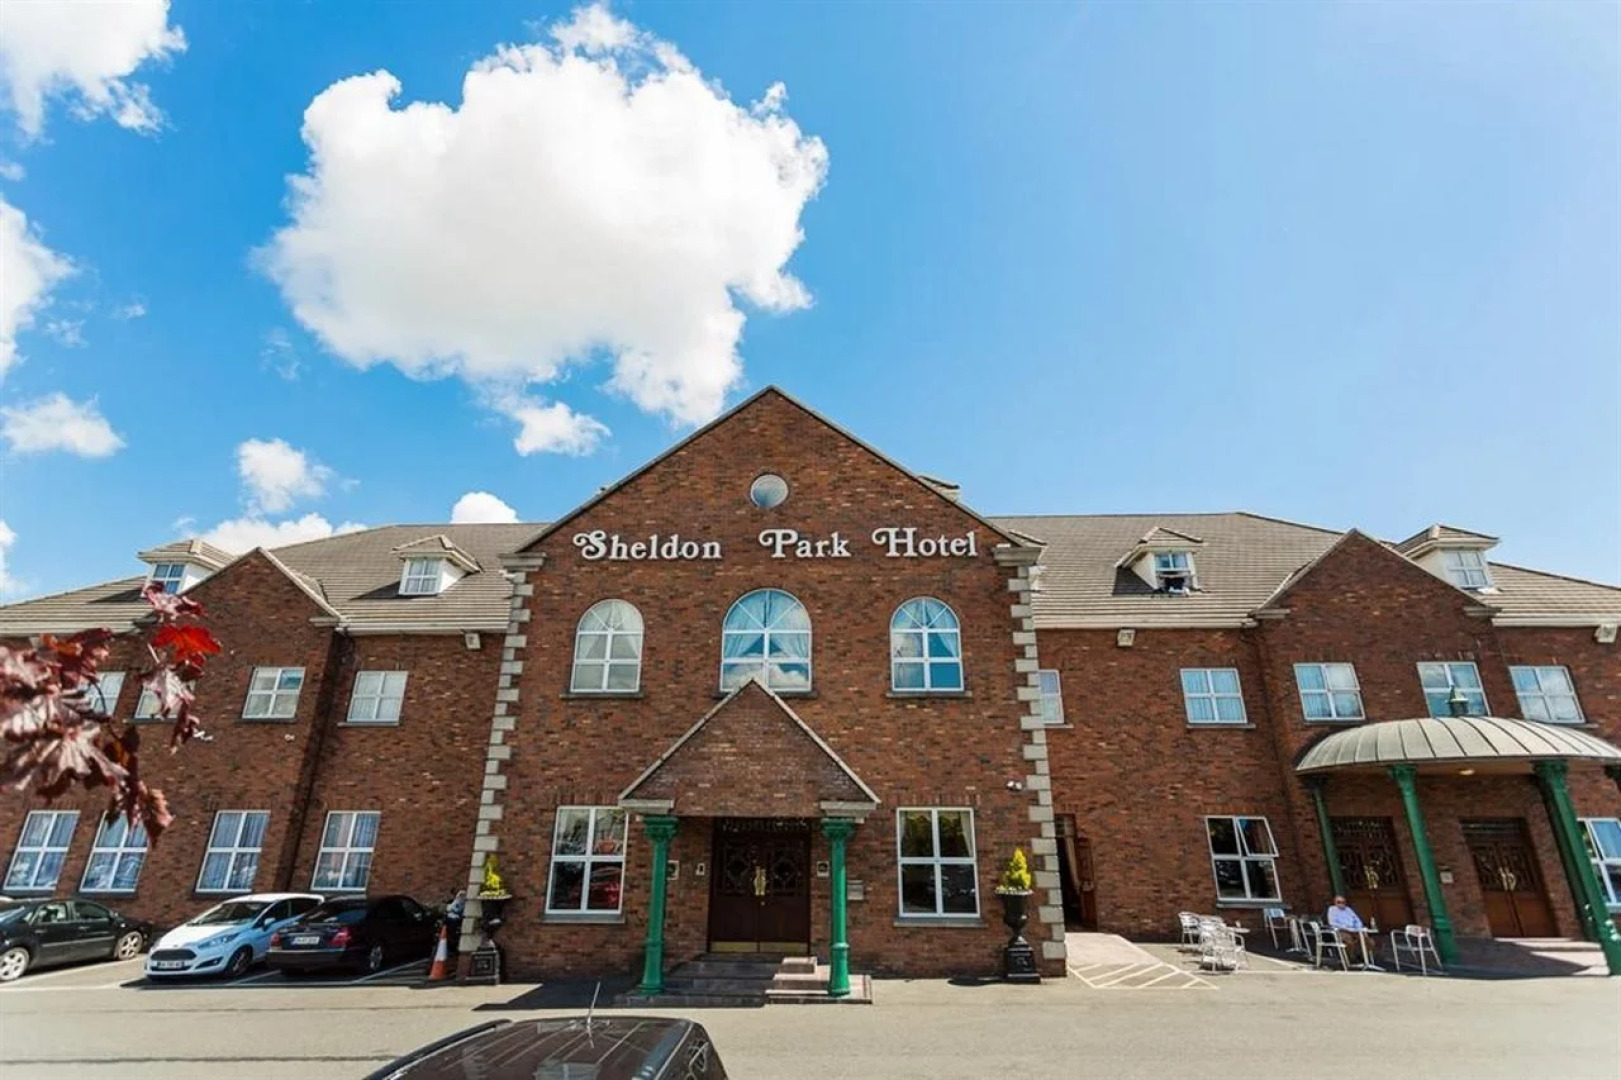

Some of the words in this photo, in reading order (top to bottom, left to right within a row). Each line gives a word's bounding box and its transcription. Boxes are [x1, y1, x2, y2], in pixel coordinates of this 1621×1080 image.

[573, 530, 722, 560] Sheldon
[758, 528, 851, 559] Park
[871, 527, 978, 558] Hotel
